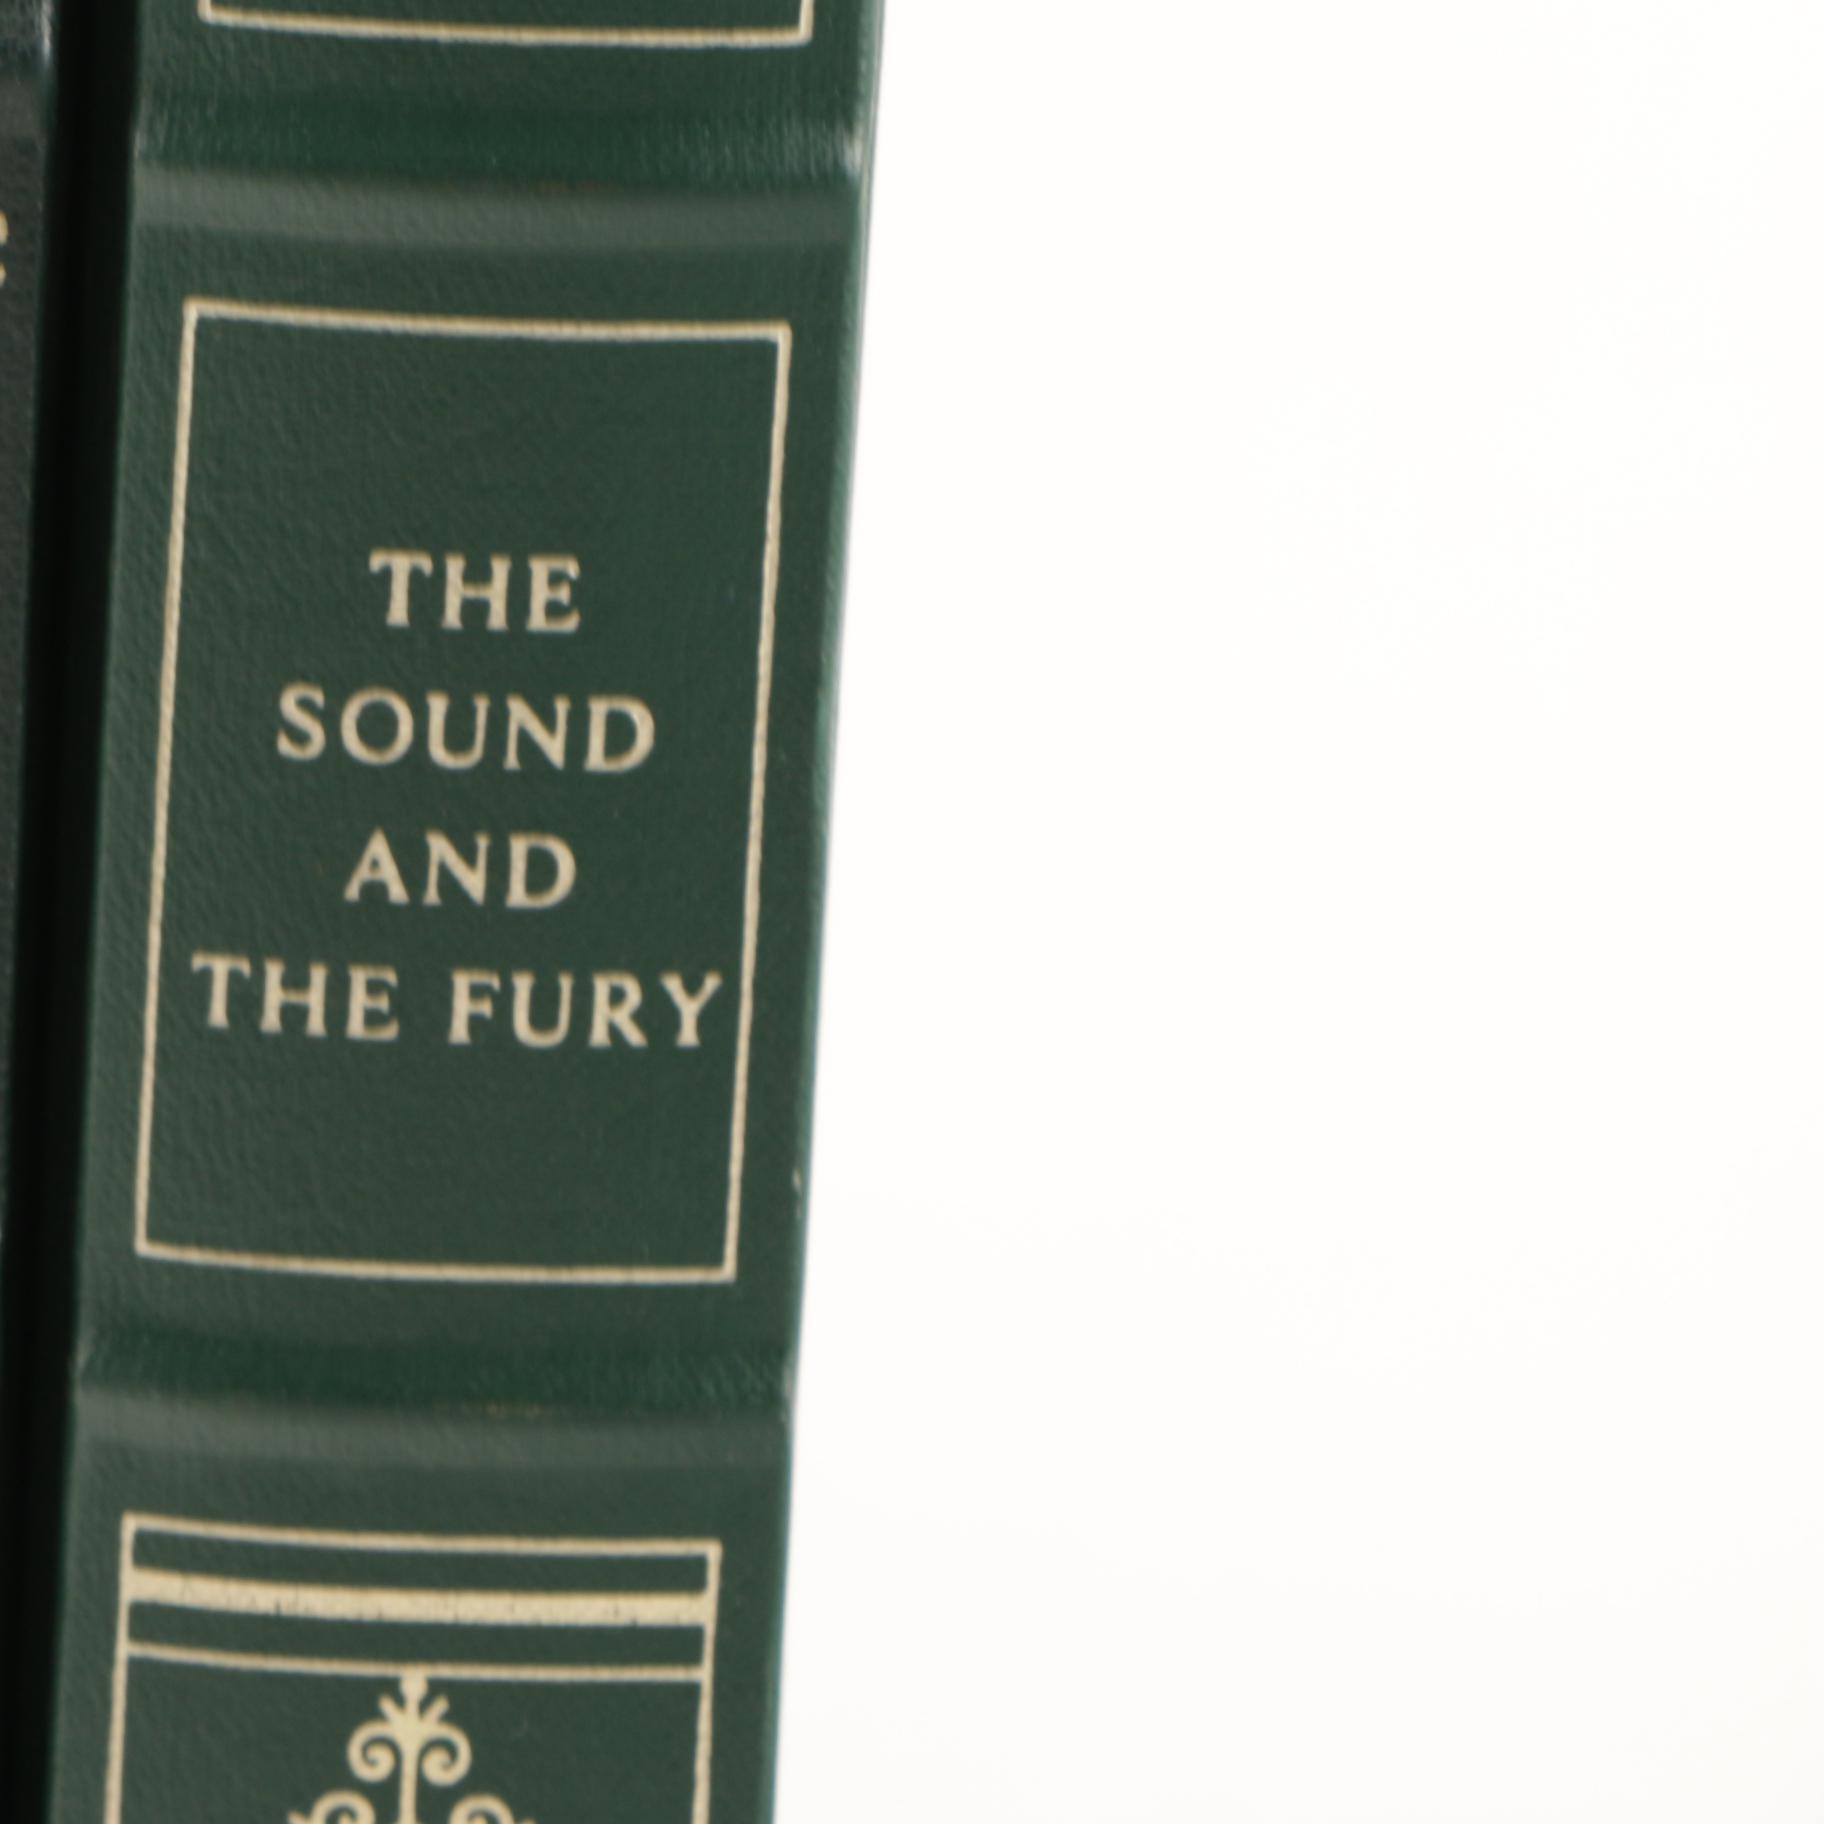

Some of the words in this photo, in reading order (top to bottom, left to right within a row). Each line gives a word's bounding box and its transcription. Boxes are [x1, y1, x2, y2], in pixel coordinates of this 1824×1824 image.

[369, 550, 580, 633] THE
[277, 683, 654, 772] SOUND
[344, 830, 576, 909] AND
[191, 952, 398, 1041] THE
[449, 970, 721, 1048] FURY
